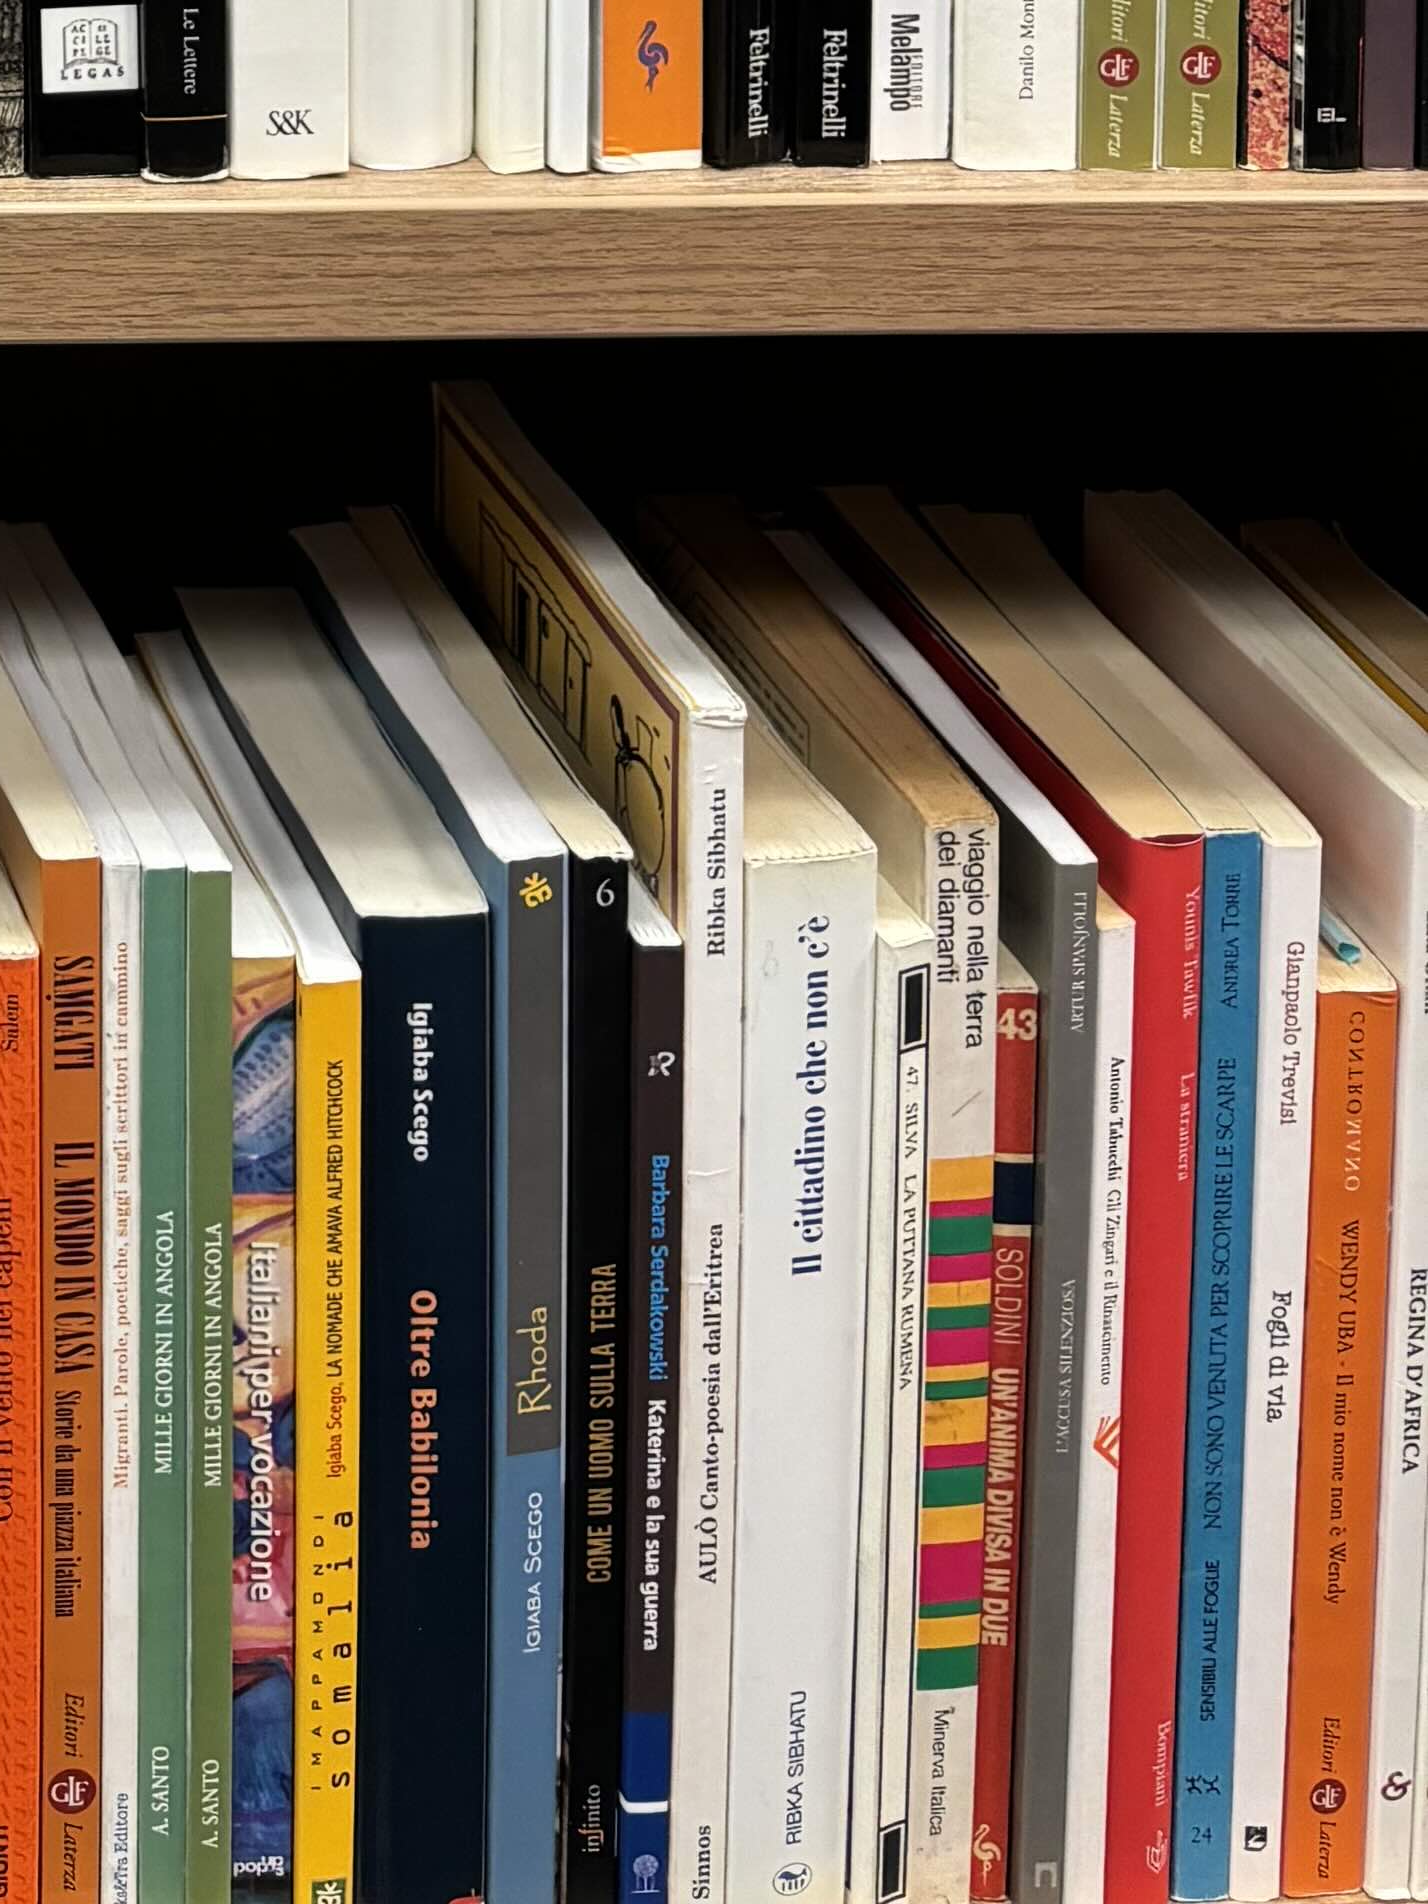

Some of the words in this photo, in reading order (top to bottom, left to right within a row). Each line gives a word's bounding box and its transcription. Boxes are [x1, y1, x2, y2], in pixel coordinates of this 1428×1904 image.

[822, 29, 848, 138] Feltrinelli
[406, 1003, 434, 1081] Igiaba
[407, 1089, 433, 1162] Scego
[410, 1290, 438, 1377] Oltre
[1266, 1291, 1292, 1349] Fogli
[1266, 1385, 1286, 1423] via
[1269, 1356, 1289, 1379] di
[411, 1389, 438, 1548] Babilonia
